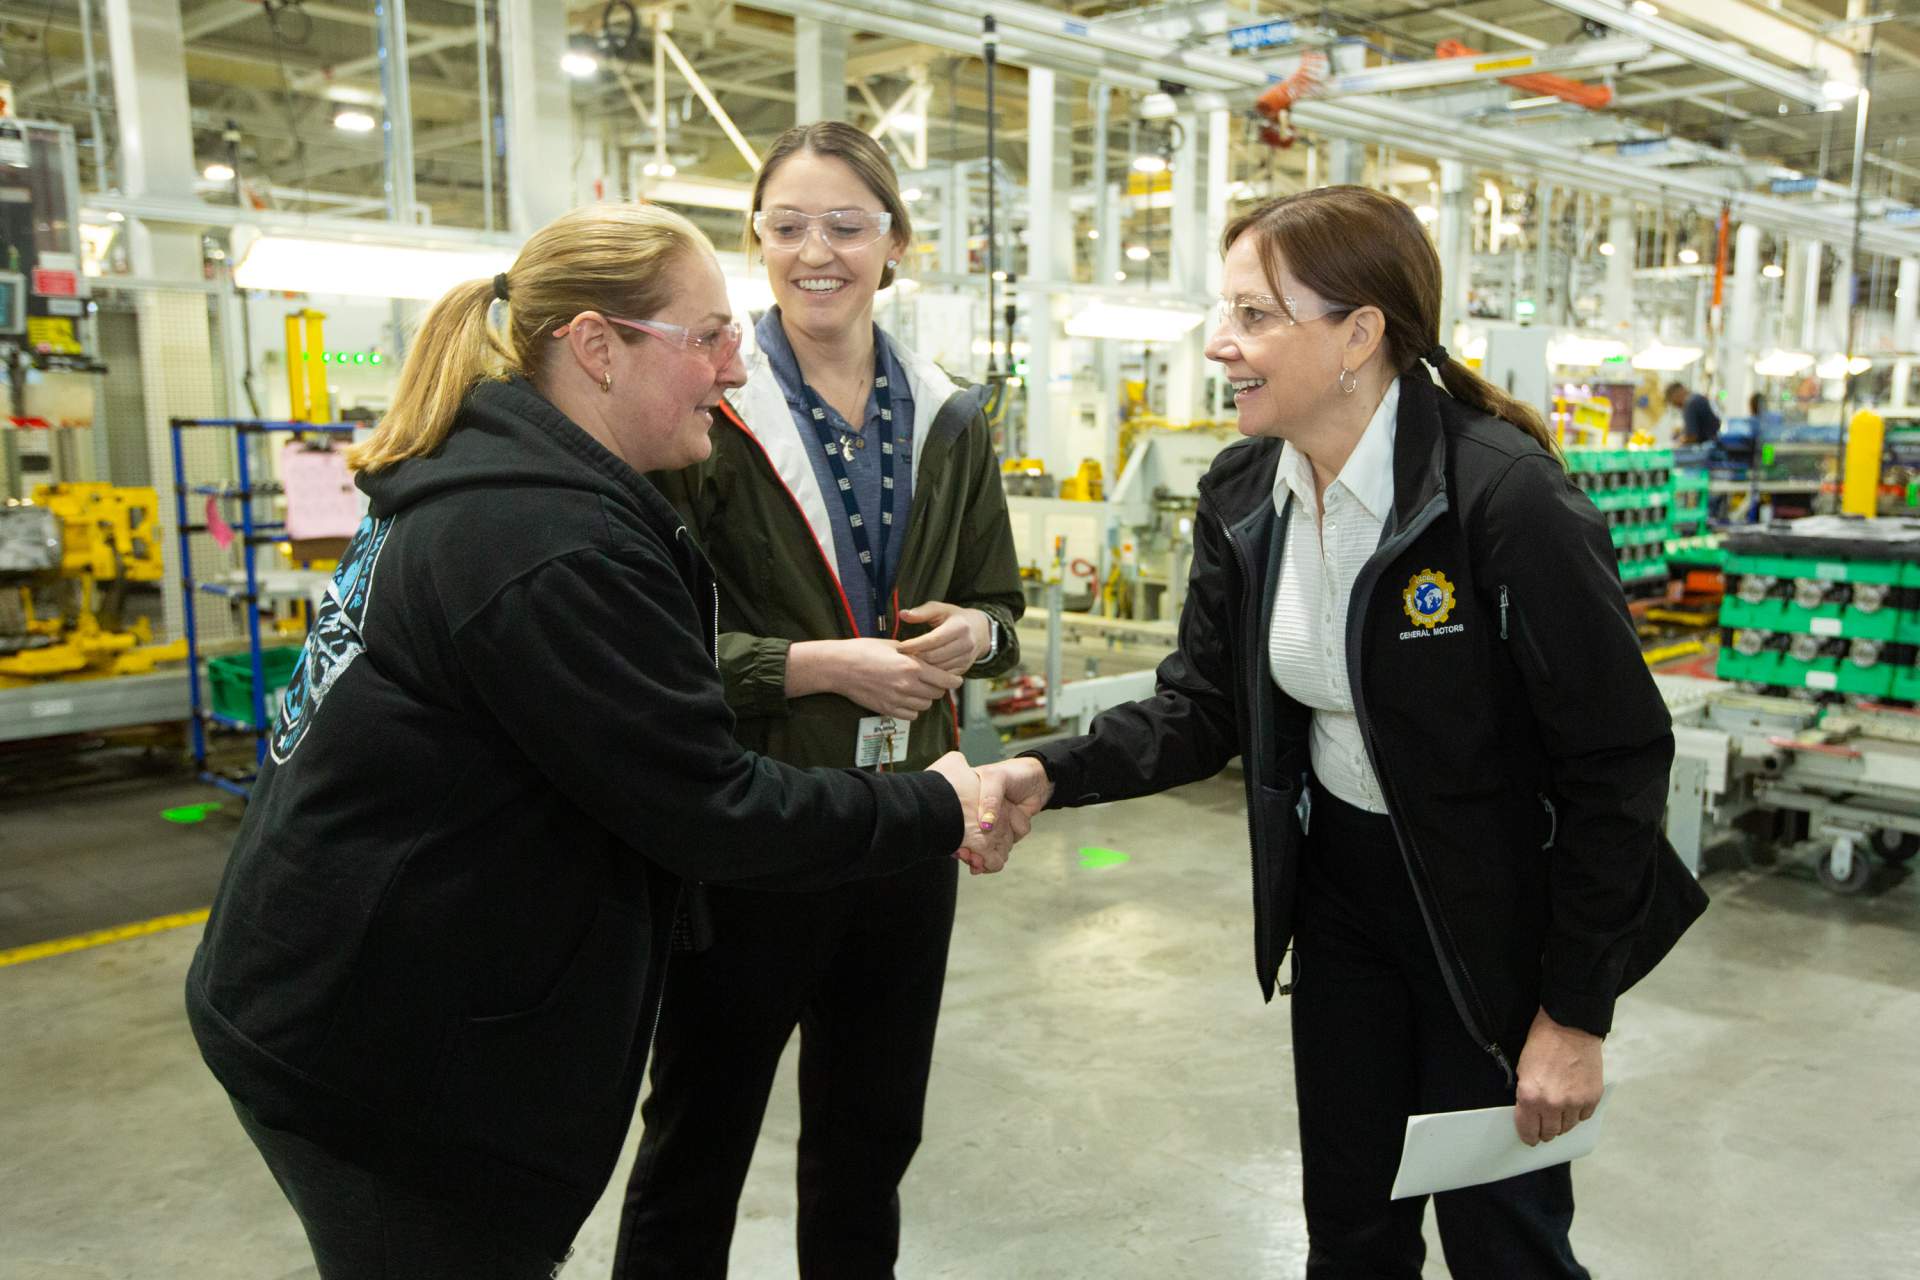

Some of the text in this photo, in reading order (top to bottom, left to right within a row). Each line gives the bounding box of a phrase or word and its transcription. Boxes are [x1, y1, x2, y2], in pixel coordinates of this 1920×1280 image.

[812, 408, 825, 420] GM
[825, 443, 838, 455] GM
[839, 478, 851, 491] GM
[850, 514, 863, 527] GM
[860, 551, 872, 564] GM
[1400, 624, 1464, 640] GENERAL MOTORS
